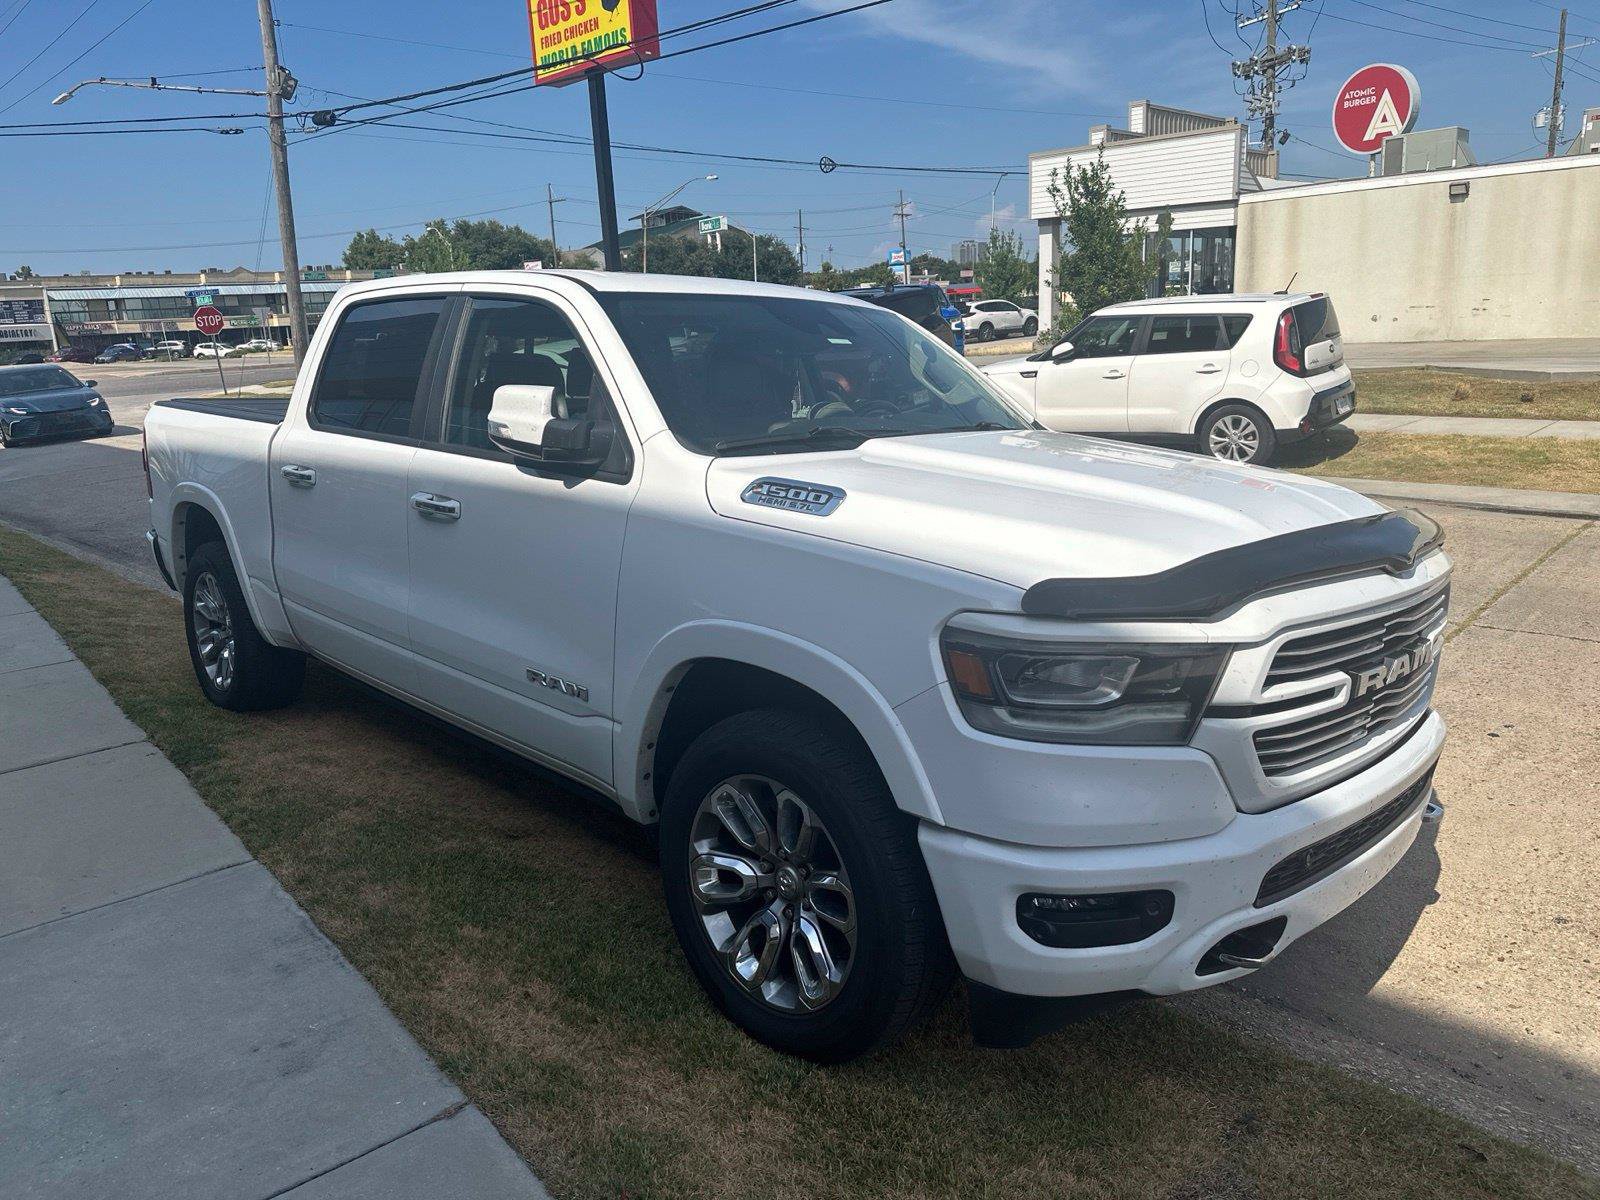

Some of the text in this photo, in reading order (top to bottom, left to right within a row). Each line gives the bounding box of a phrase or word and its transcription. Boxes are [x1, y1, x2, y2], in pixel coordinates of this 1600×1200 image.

[541, 17, 599, 50] FRIED CHICKEN
[581, 27, 627, 56] FAMOUS
[1343, 96, 1377, 109] BURGER
[1344, 87, 1376, 100] ATOMIC
[1362, 87, 1403, 142] A
[197, 315, 221, 327] STOP
[753, 483, 831, 505] 1500
[758, 496, 814, 511] HEMI 5.7L
[1355, 640, 1435, 698] RAM
[526, 667, 589, 702] RAM
